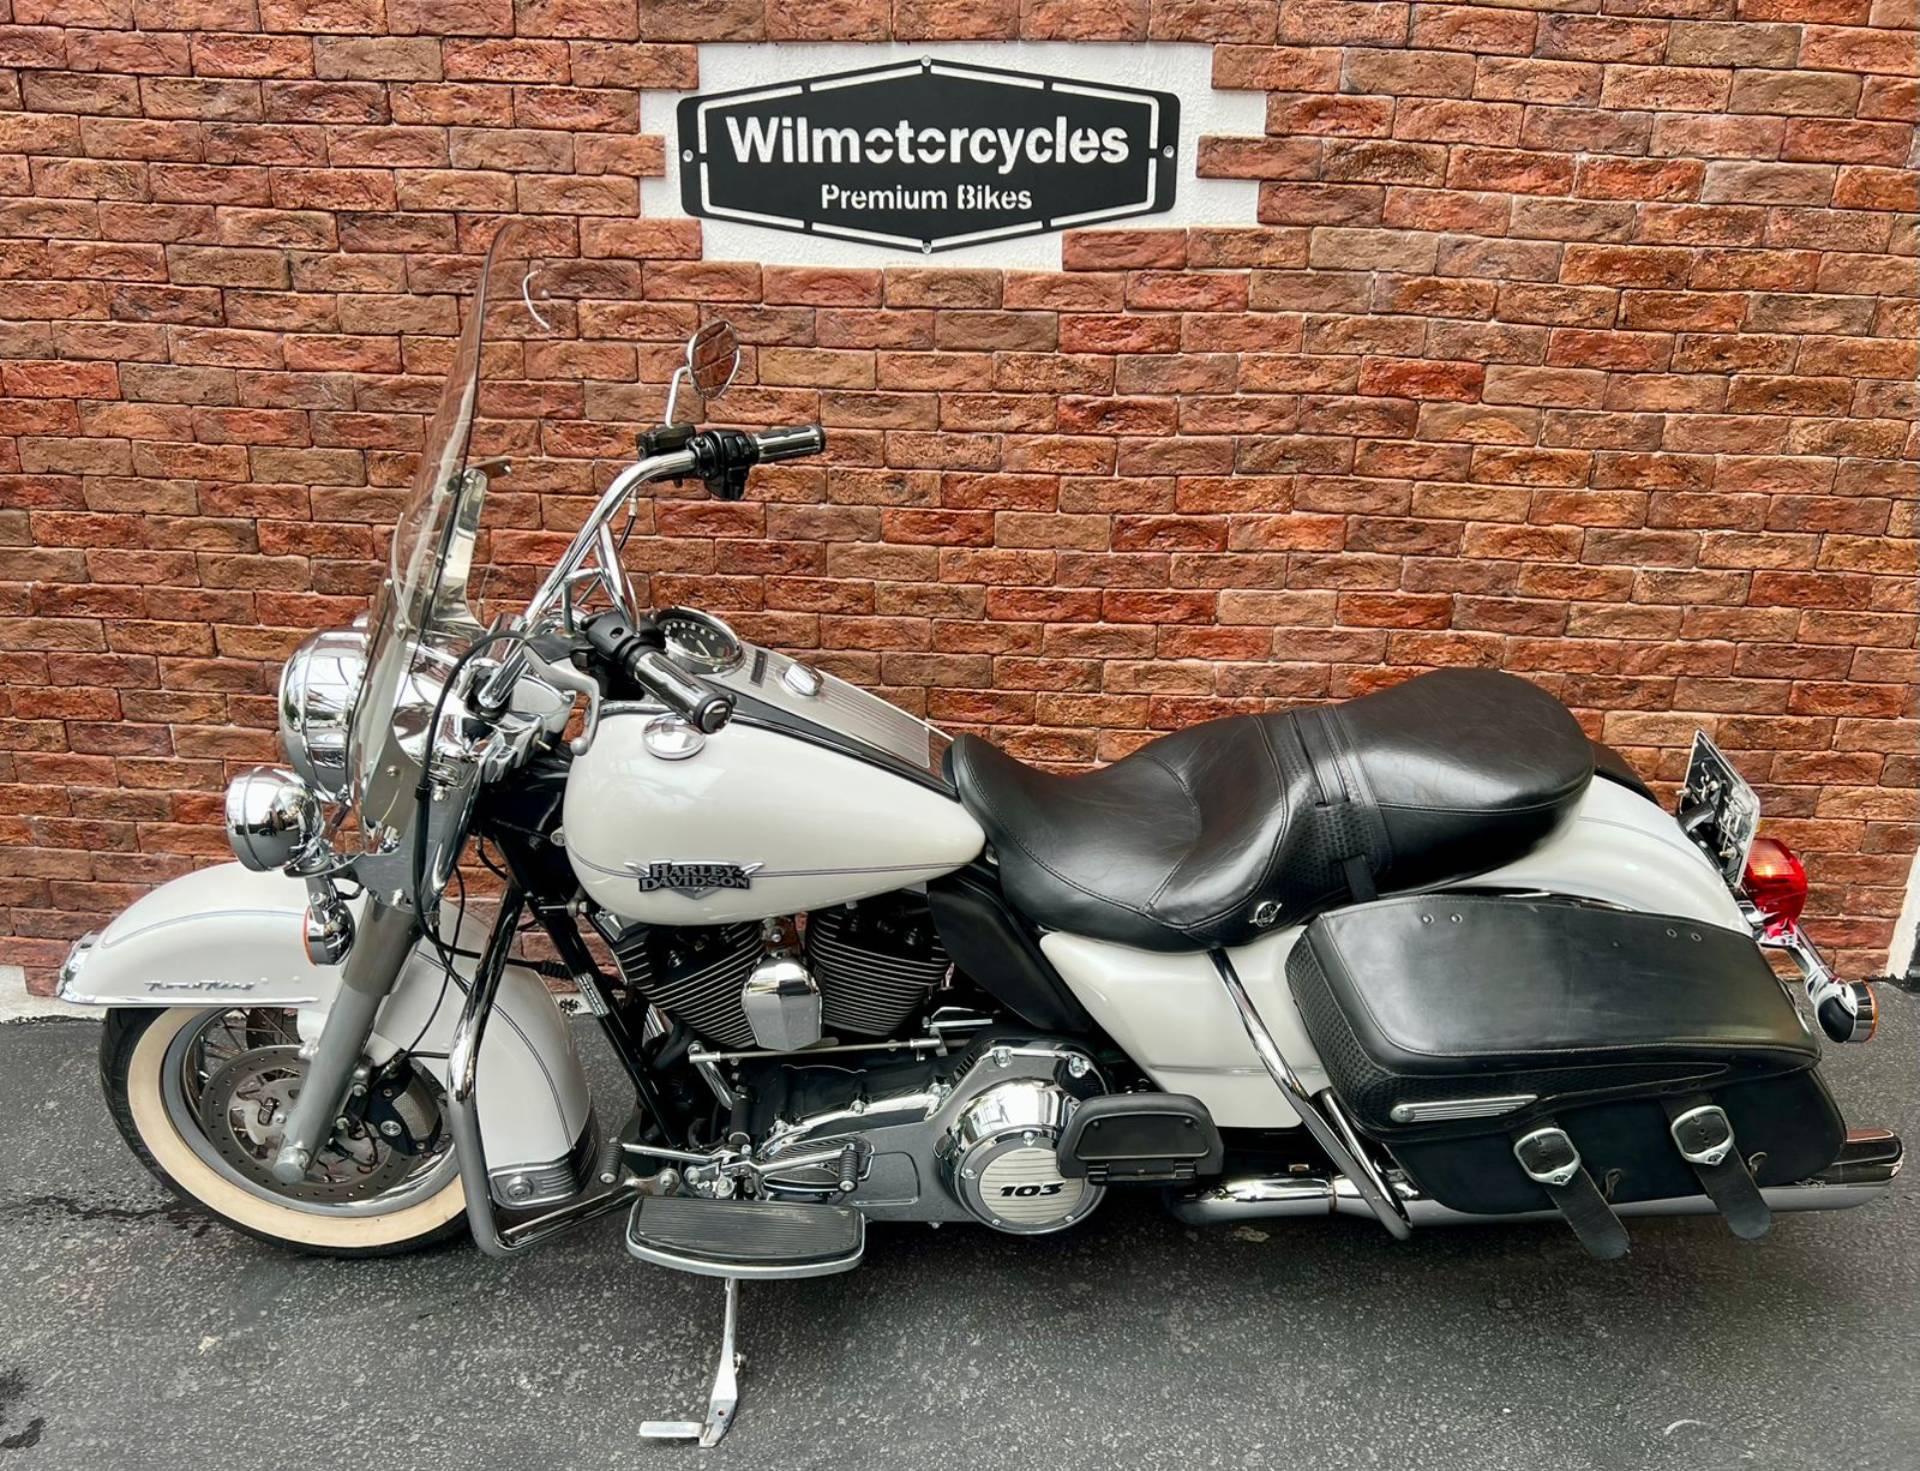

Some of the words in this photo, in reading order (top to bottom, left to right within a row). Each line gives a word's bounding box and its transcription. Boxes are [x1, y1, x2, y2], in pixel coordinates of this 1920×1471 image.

[725, 116, 1130, 174] Wilmotorcycles
[821, 184, 948, 210] Premium
[957, 184, 1033, 210] Bikes
[641, 876, 749, 890] DAVIDSON
[1001, 1182, 1065, 1197] 103
